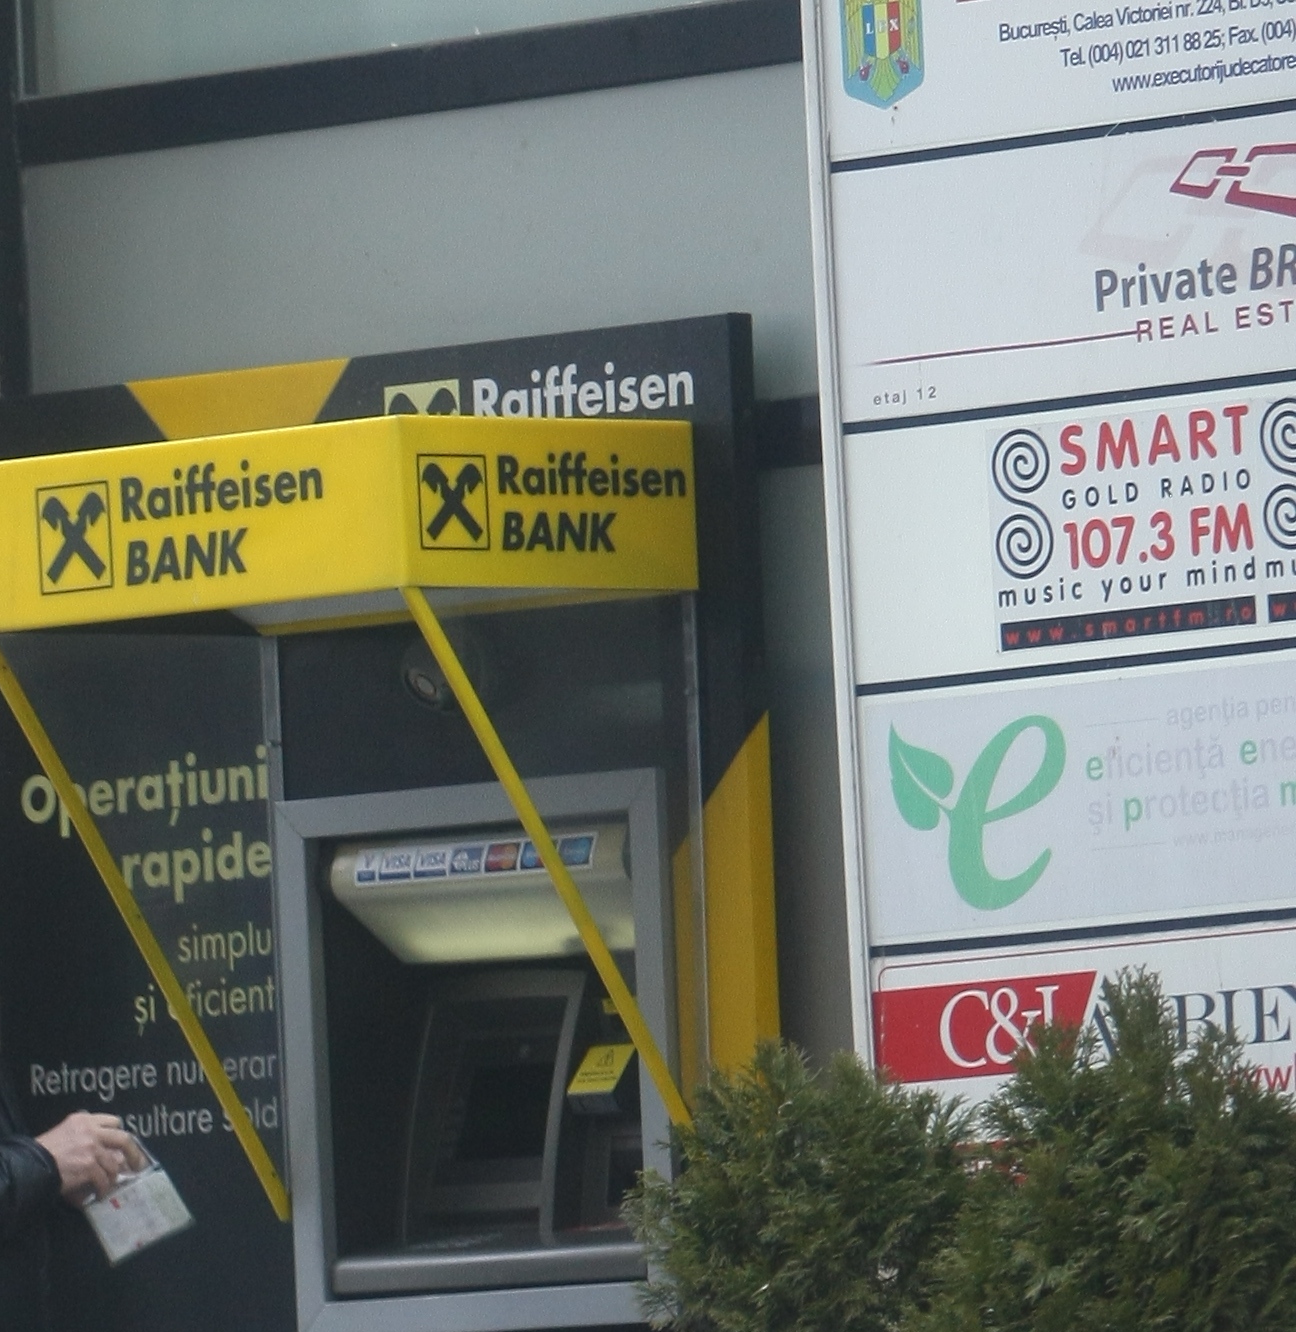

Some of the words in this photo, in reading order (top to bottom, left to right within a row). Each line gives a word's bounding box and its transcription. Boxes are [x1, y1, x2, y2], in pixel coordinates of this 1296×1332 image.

[1073, 12, 1113, 32] Calea
[1116, 1, 1173, 26] Victoriei
[1176, 3, 1194, 17] nr.
[1060, 48, 1085, 67] Tel.
[1089, 42, 1123, 67] (004)
[1126, 39, 1151, 59] 021
[1154, 35, 1179, 56] 311
[1184, 31, 1201, 51] 88
[1204, 29, 1225, 49] 25;
[1228, 26, 1258, 46] Fax.
[1262, 18, 1296, 45] (004)
[1095, 258, 1237, 312] Private
[1249, 243, 1296, 291] BR
[1136, 311, 1219, 343] REAL
[1235, 300, 1294, 330] EST
[473, 361, 694, 418] Raiffeisen
[872, 389, 907, 406] etaj
[917, 386, 936, 400] 12
[1059, 404, 1249, 476] SMART
[119, 461, 325, 524] Raiffeisen
[496, 452, 688, 501] Raiffeisen
[1061, 481, 1139, 510] GOLD
[1160, 468, 1252, 499] RADIO
[125, 527, 247, 586] BANK
[502, 511, 617, 553] BANK
[1063, 510, 1176, 570] 107.3
[1189, 503, 1254, 556] FM
[998, 577, 1083, 607] music
[1102, 571, 1167, 602] your
[1187, 556, 1255, 587] mind
[122, 827, 273, 903] rapide
[177, 921, 273, 973] simplu
[30, 1061, 157, 1103] Retragere
[223, 1096, 278, 1133] sld
